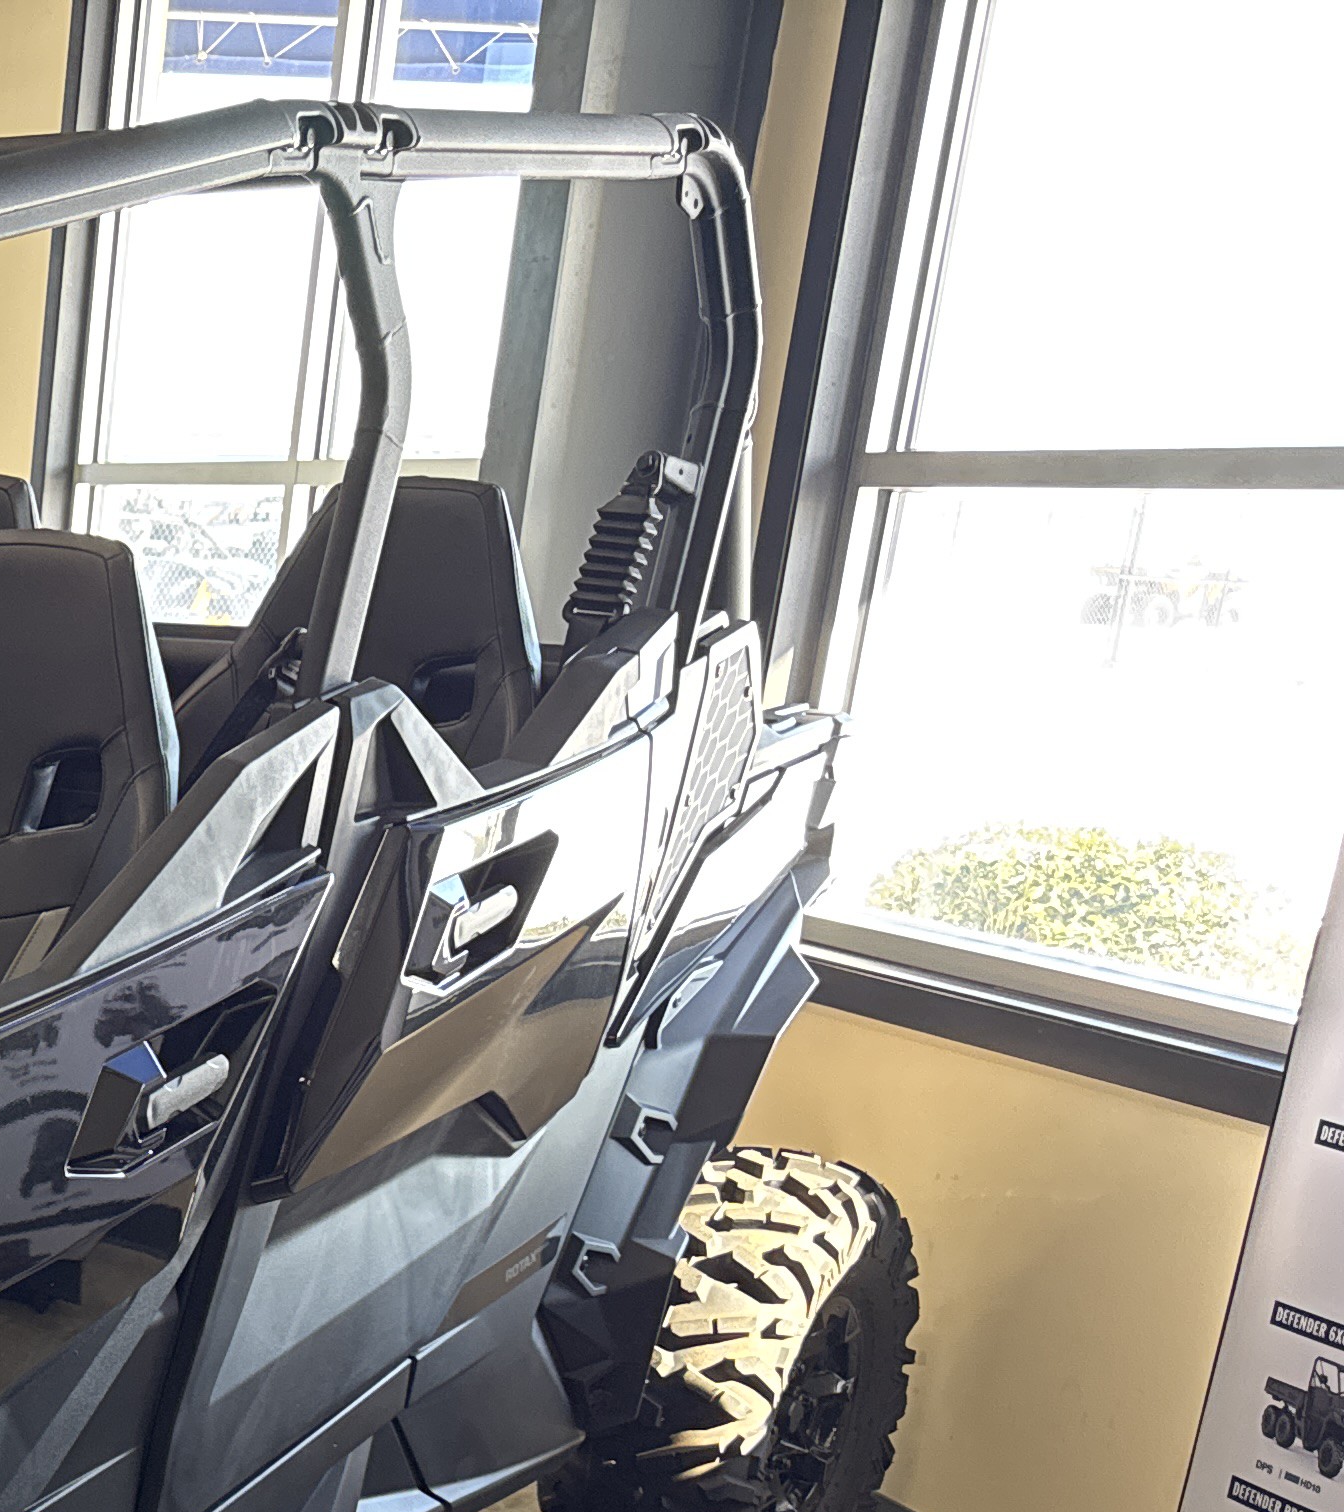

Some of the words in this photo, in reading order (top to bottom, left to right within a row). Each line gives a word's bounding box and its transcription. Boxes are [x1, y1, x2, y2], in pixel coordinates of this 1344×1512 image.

[1275, 1306, 1328, 1339] DEFENDER
[1255, 1459, 1273, 1475] DPS
[1300, 1477, 1322, 1494] HD10
